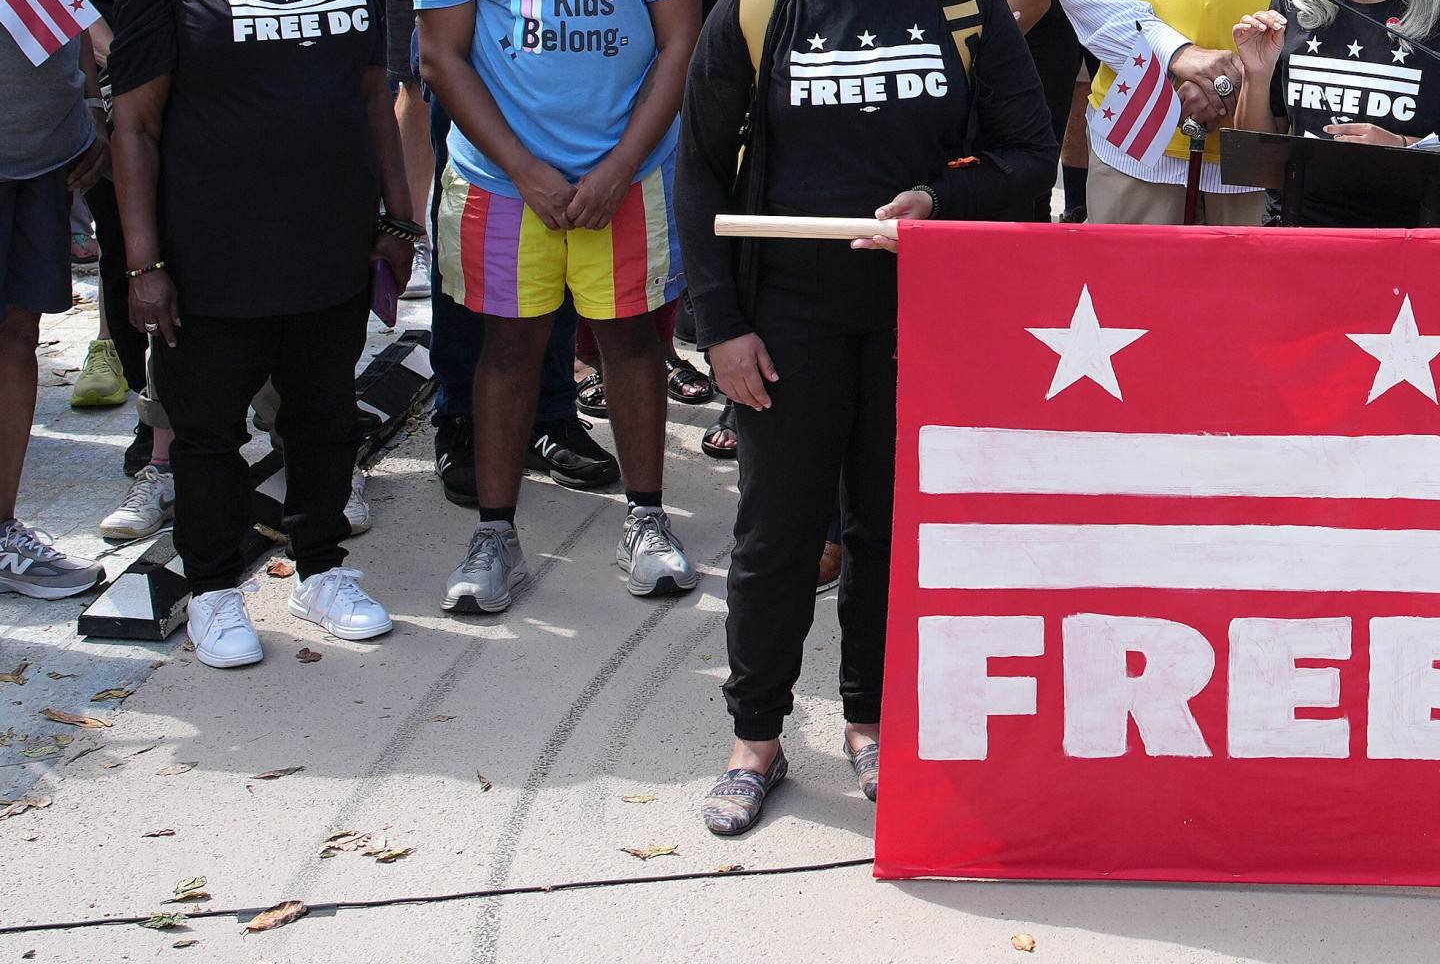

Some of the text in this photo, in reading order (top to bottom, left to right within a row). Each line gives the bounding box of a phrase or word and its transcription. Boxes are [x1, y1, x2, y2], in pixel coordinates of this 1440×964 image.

[232, 8, 370, 43] FREE DC
[523, 17, 620, 57] Belong
[791, 72, 948, 107] FREE DC
[1286, 81, 1417, 122] FREE DC
